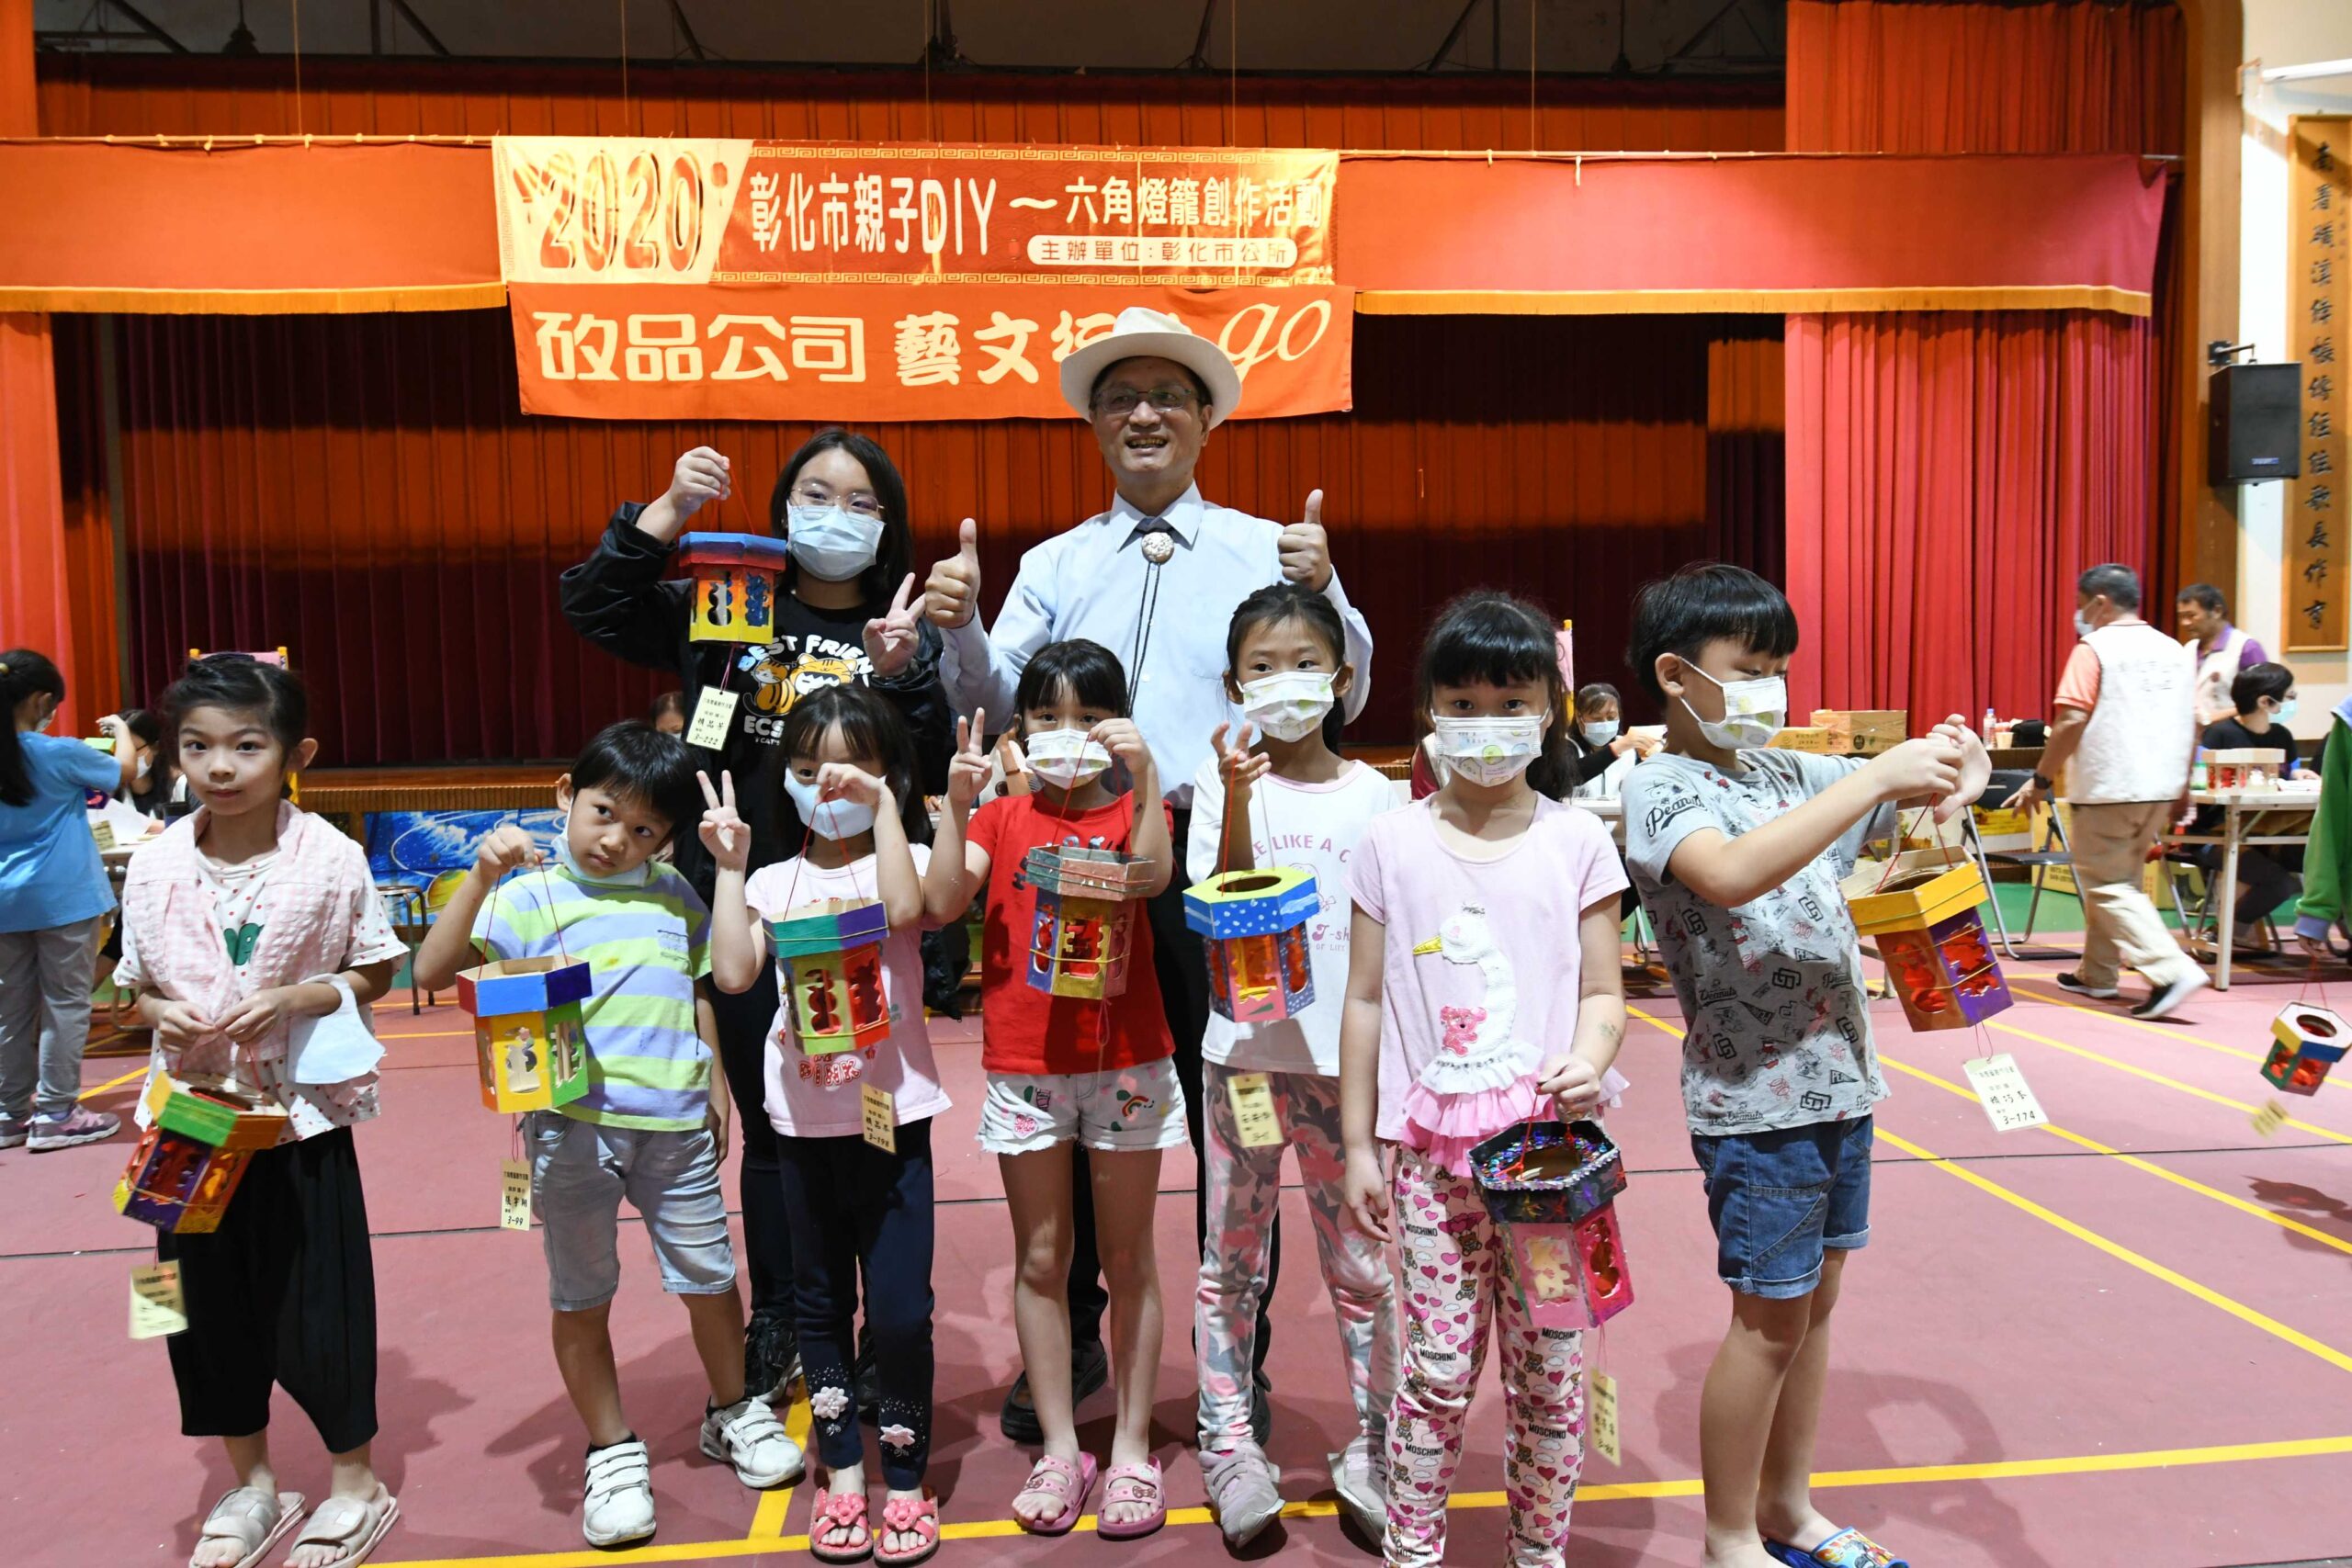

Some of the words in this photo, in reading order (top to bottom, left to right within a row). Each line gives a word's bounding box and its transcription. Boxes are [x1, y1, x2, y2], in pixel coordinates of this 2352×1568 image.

[539, 151, 704, 272] 2020
[806, 634, 874, 688] FRIEN
[1272, 834, 1314, 851] LIKE
[1319, 837, 1332, 852] A
[2003, 1111, 2036, 1125] 3-174
[1406, 1223, 1438, 1236] MOSCHINO
[1419, 1348, 1457, 1361] MOSCHINO
[1528, 1423, 1566, 1439] MOSCHINO
[1405, 1442, 1443, 1457] MOSCHINO
